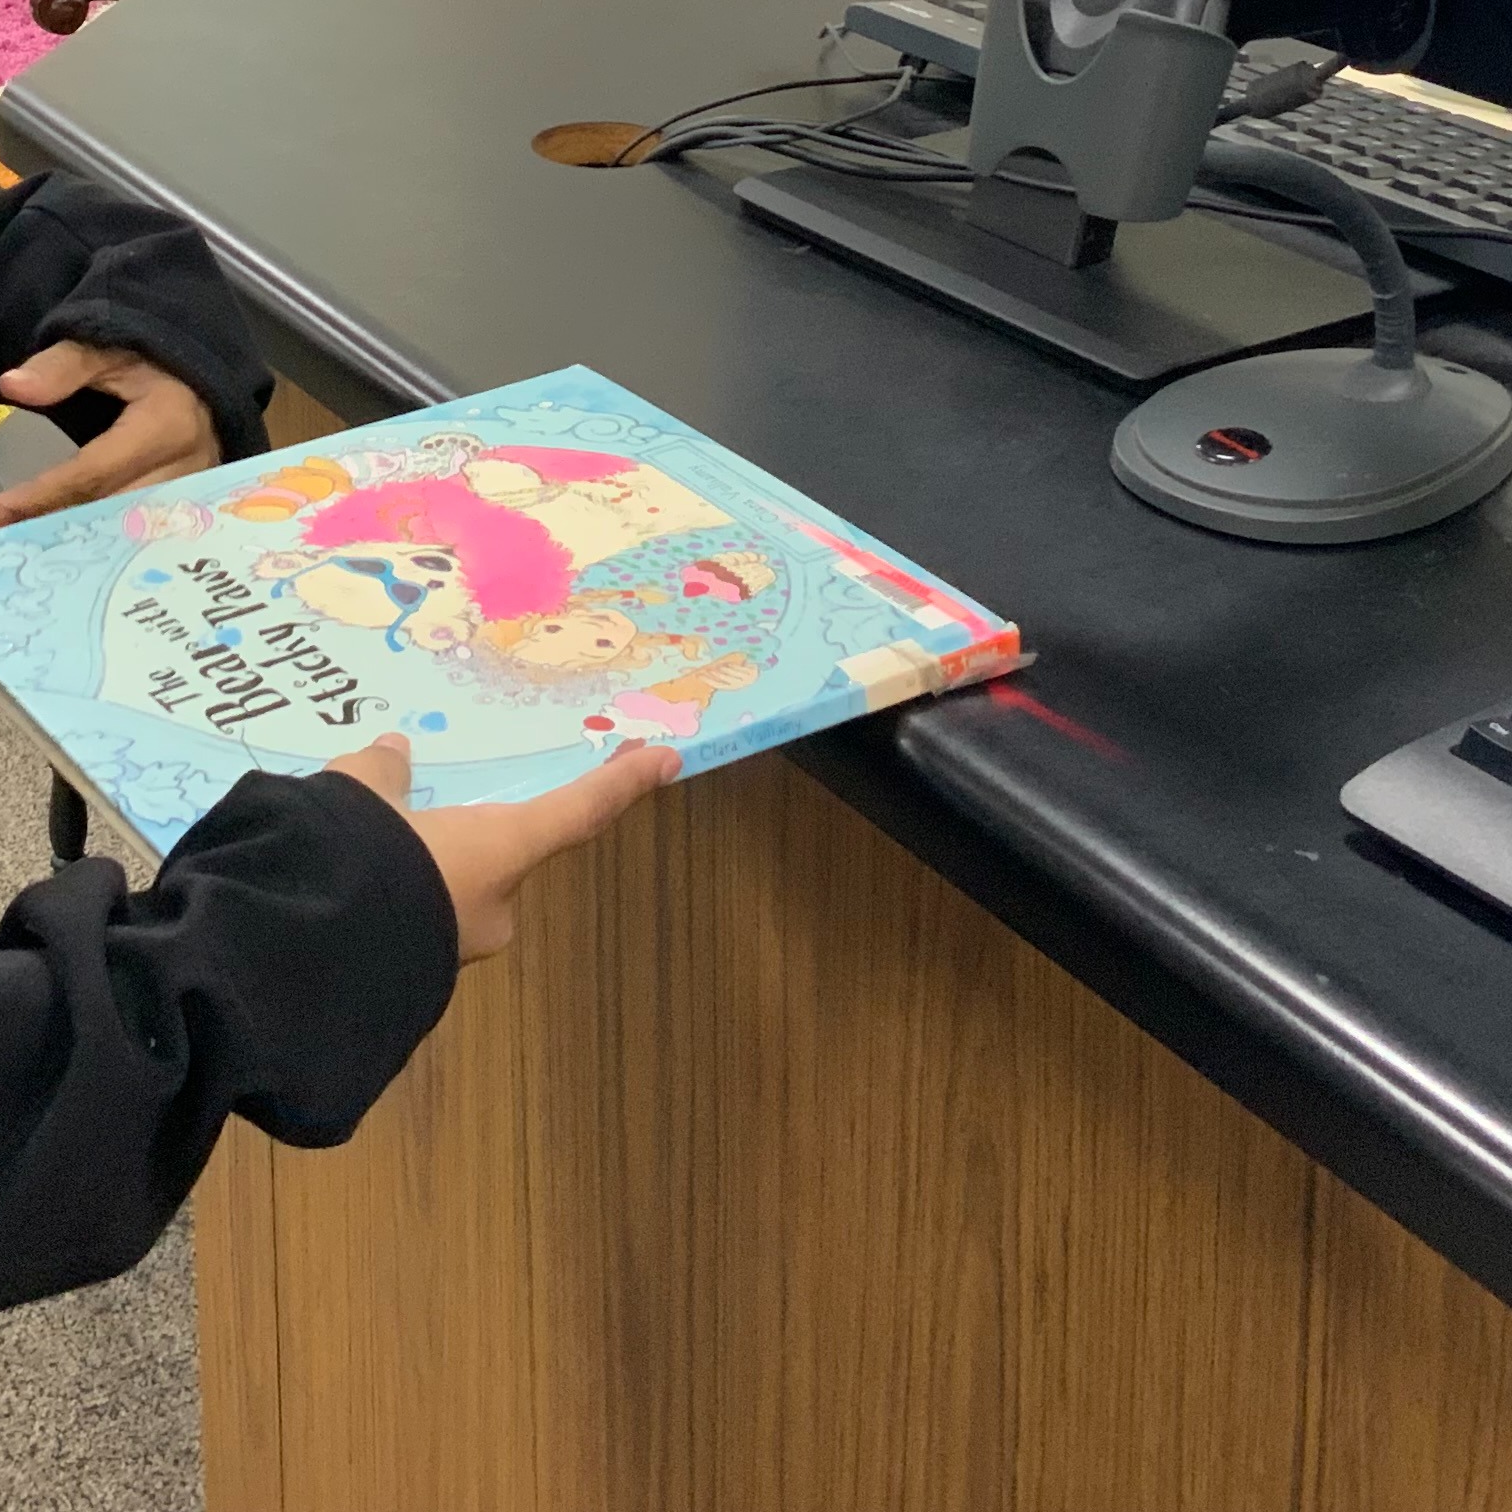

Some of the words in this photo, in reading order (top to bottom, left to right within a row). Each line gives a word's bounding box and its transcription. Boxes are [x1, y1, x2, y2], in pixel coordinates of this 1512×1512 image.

[122, 597, 190, 642] with
[178, 558, 268, 629] Paws
[148, 666, 203, 713] The
[185, 642, 291, 735] Bear
[256, 618, 389, 726] Sticky
[699, 740, 738, 762] Clara
